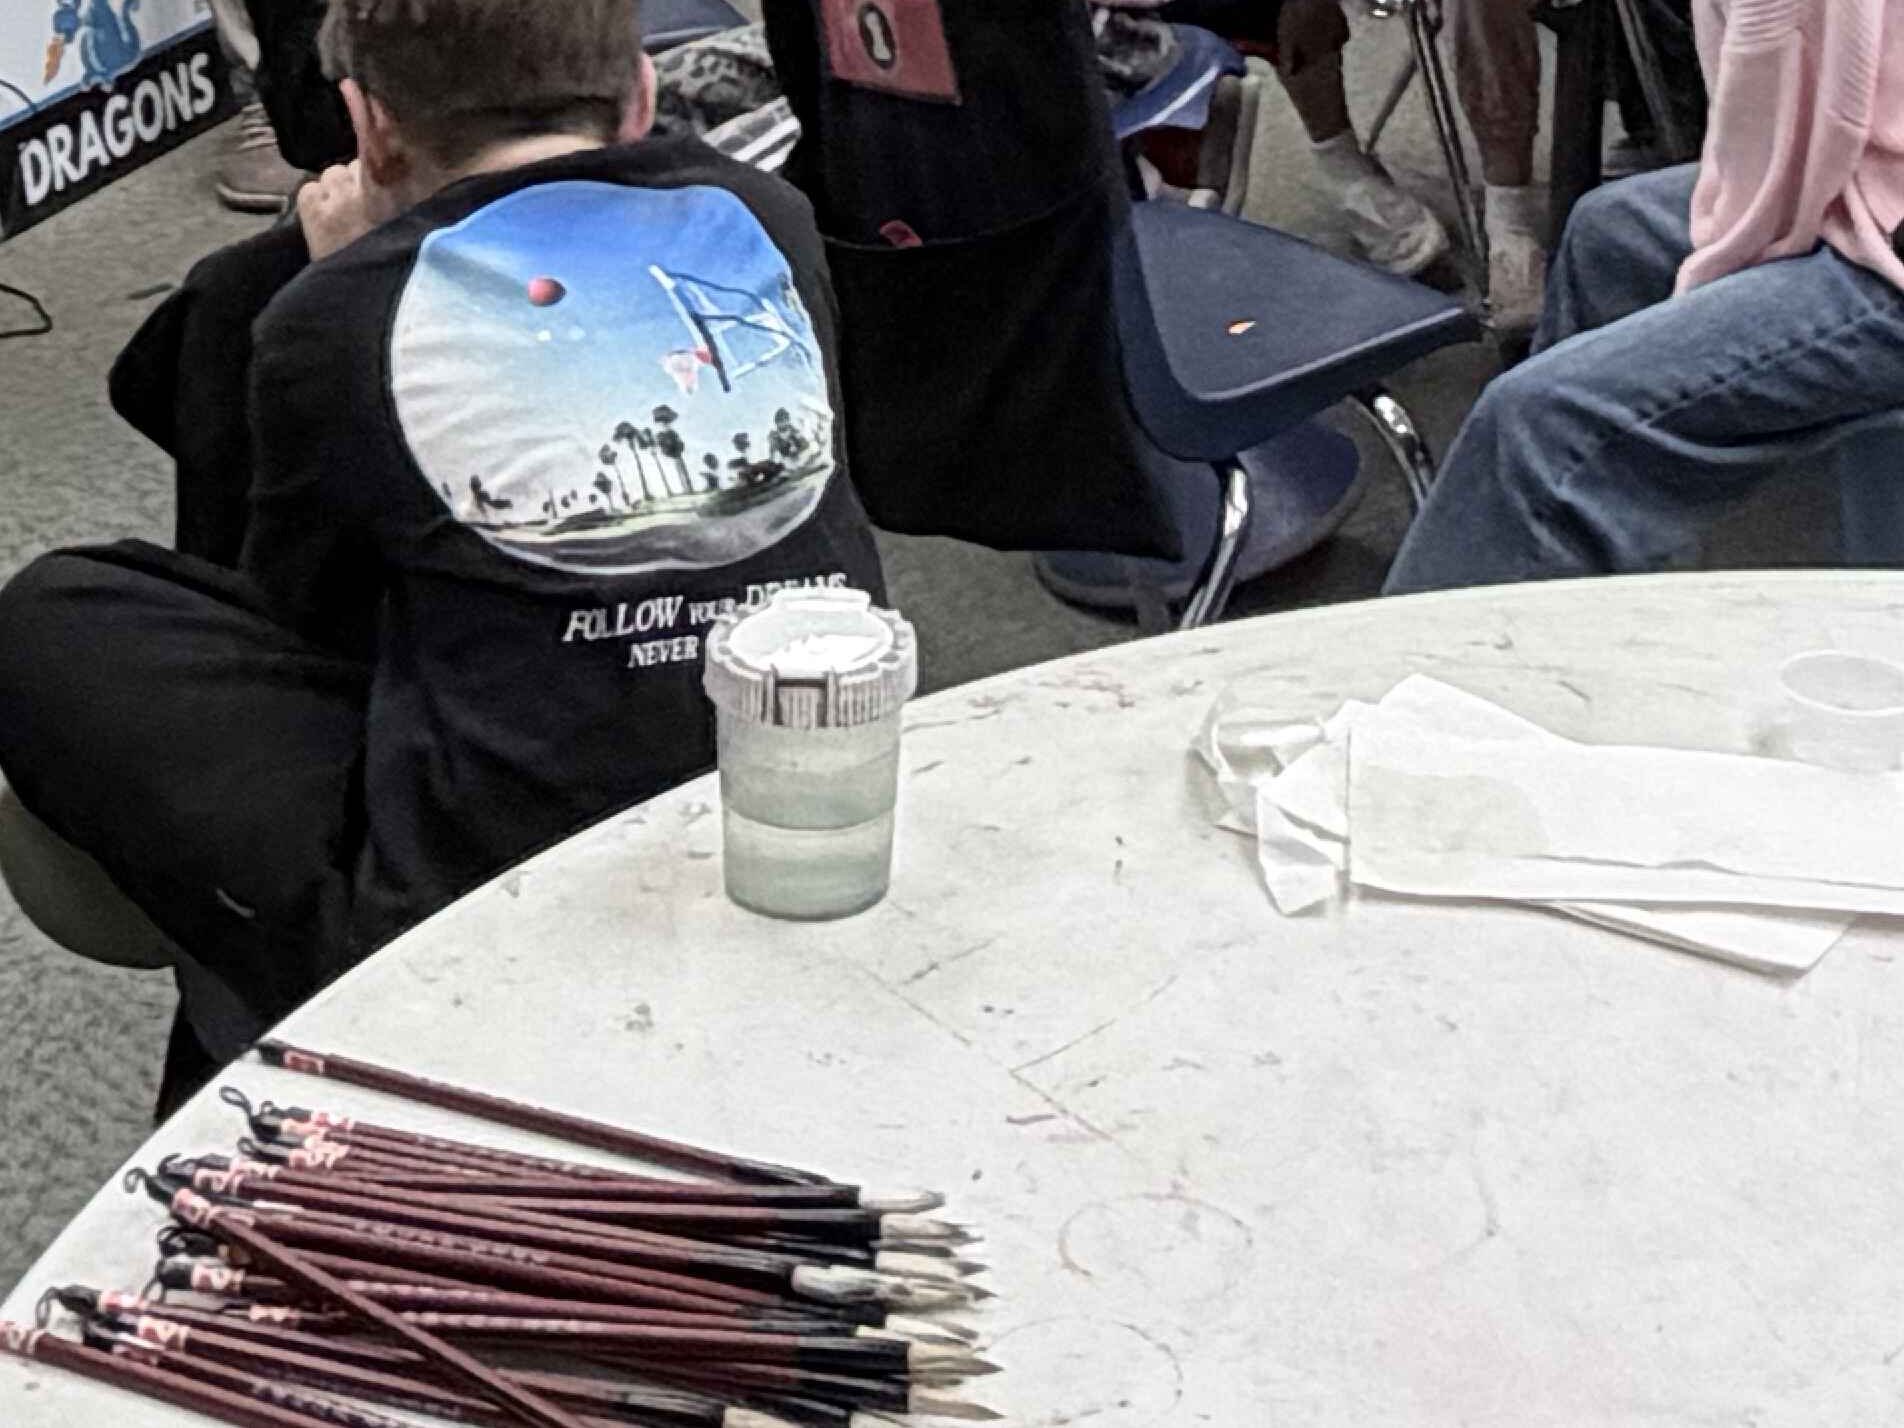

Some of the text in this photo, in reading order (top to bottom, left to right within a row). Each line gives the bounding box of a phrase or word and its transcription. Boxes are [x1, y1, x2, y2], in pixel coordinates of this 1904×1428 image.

[18, 52, 216, 207] DRAGONS
[561, 595, 684, 642] FOLLOW
[628, 634, 700, 669] NEVER
